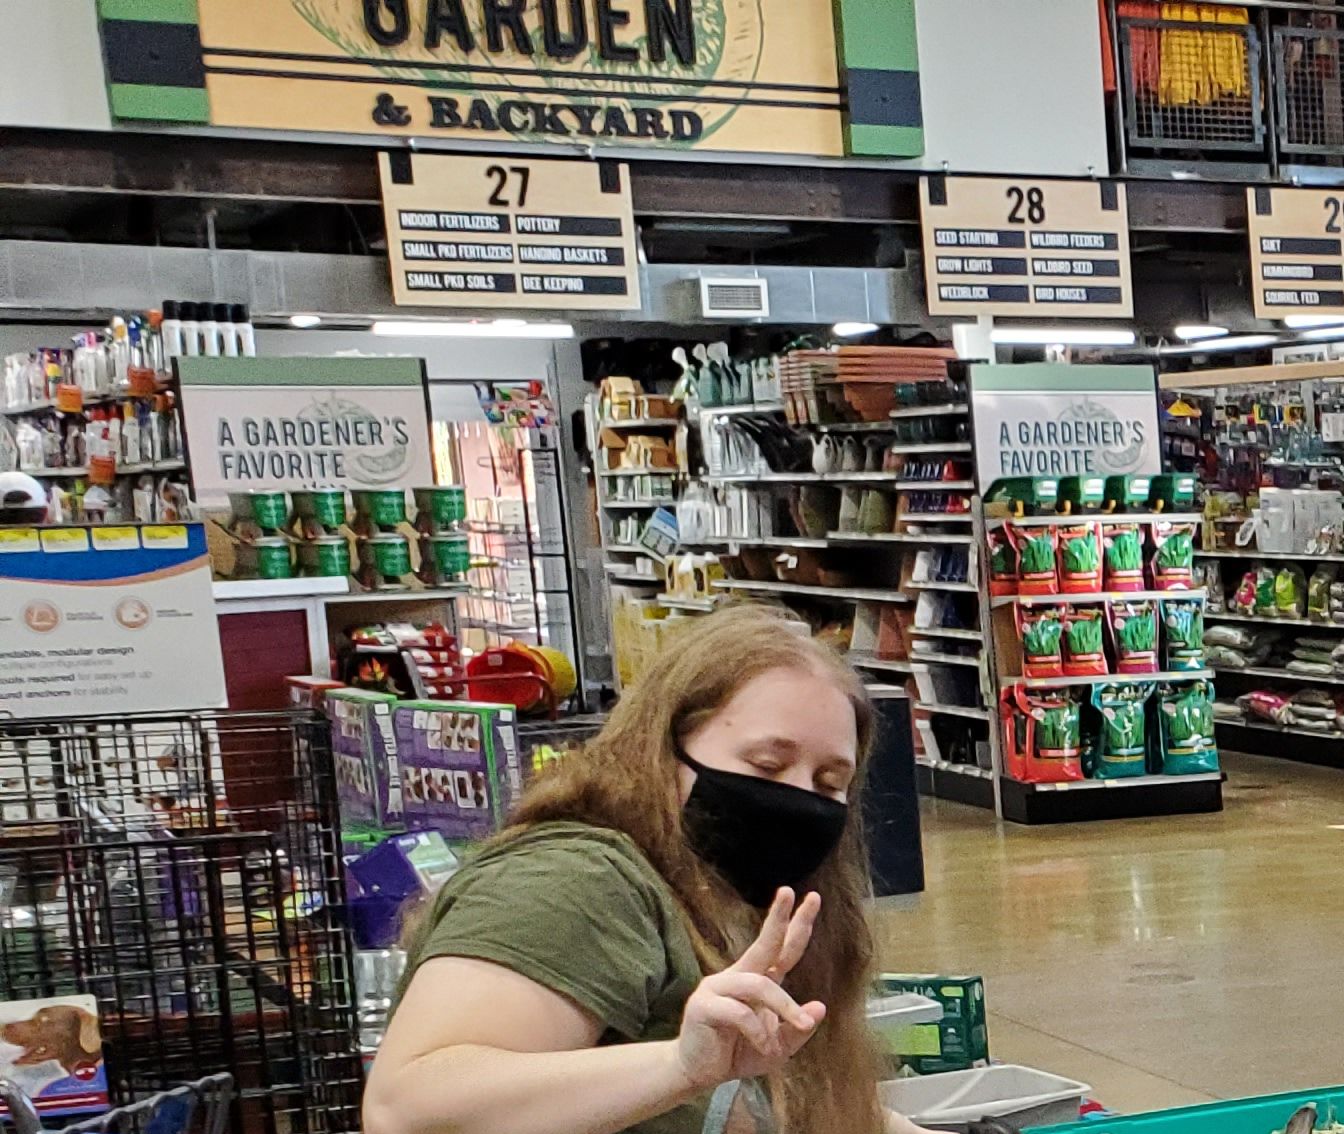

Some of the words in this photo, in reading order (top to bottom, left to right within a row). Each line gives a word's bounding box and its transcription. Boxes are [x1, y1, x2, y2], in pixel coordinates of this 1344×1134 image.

[363, 0, 697, 66] GARDEN
[372, 93, 412, 127] &
[427, 96, 704, 141] BACKYARD
[485, 165, 530, 208] 27
[1006, 186, 1046, 224] 28
[401, 212, 437, 228] INDOOR
[439, 213, 500, 231] FERTILIZERS
[516, 218, 561, 232] POTTERY
[404, 242, 436, 258] SMALL
[407, 273, 442, 289] SMALL
[466, 275, 496, 291] SOILS
[219, 418, 236, 447] A
[244, 416, 409, 447] GARDENER'S
[1000, 421, 1011, 446] A
[1018, 420, 1145, 446] GARDENER'S
[220, 451, 347, 480] FAVORITE
[1000, 450, 1095, 474] FAVORITE
